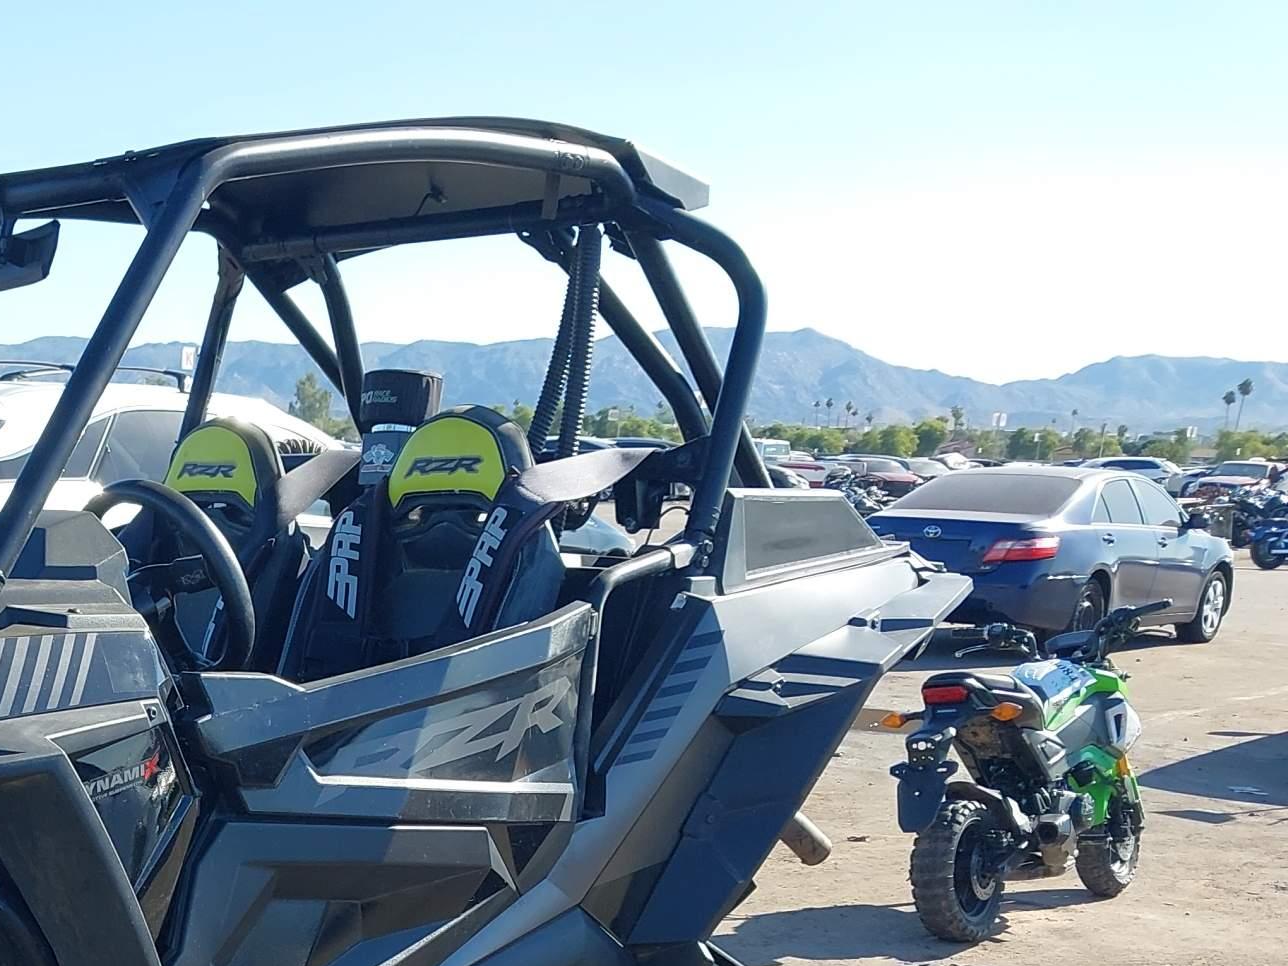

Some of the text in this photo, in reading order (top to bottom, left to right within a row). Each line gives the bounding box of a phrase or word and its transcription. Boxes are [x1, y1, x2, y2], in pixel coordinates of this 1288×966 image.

[178, 462, 237, 480] RZR
[404, 455, 484, 480] RZR
[456, 506, 508, 629] PRP
[315, 676, 573, 808] RZR
[86, 751, 161, 796] YNAMIX
